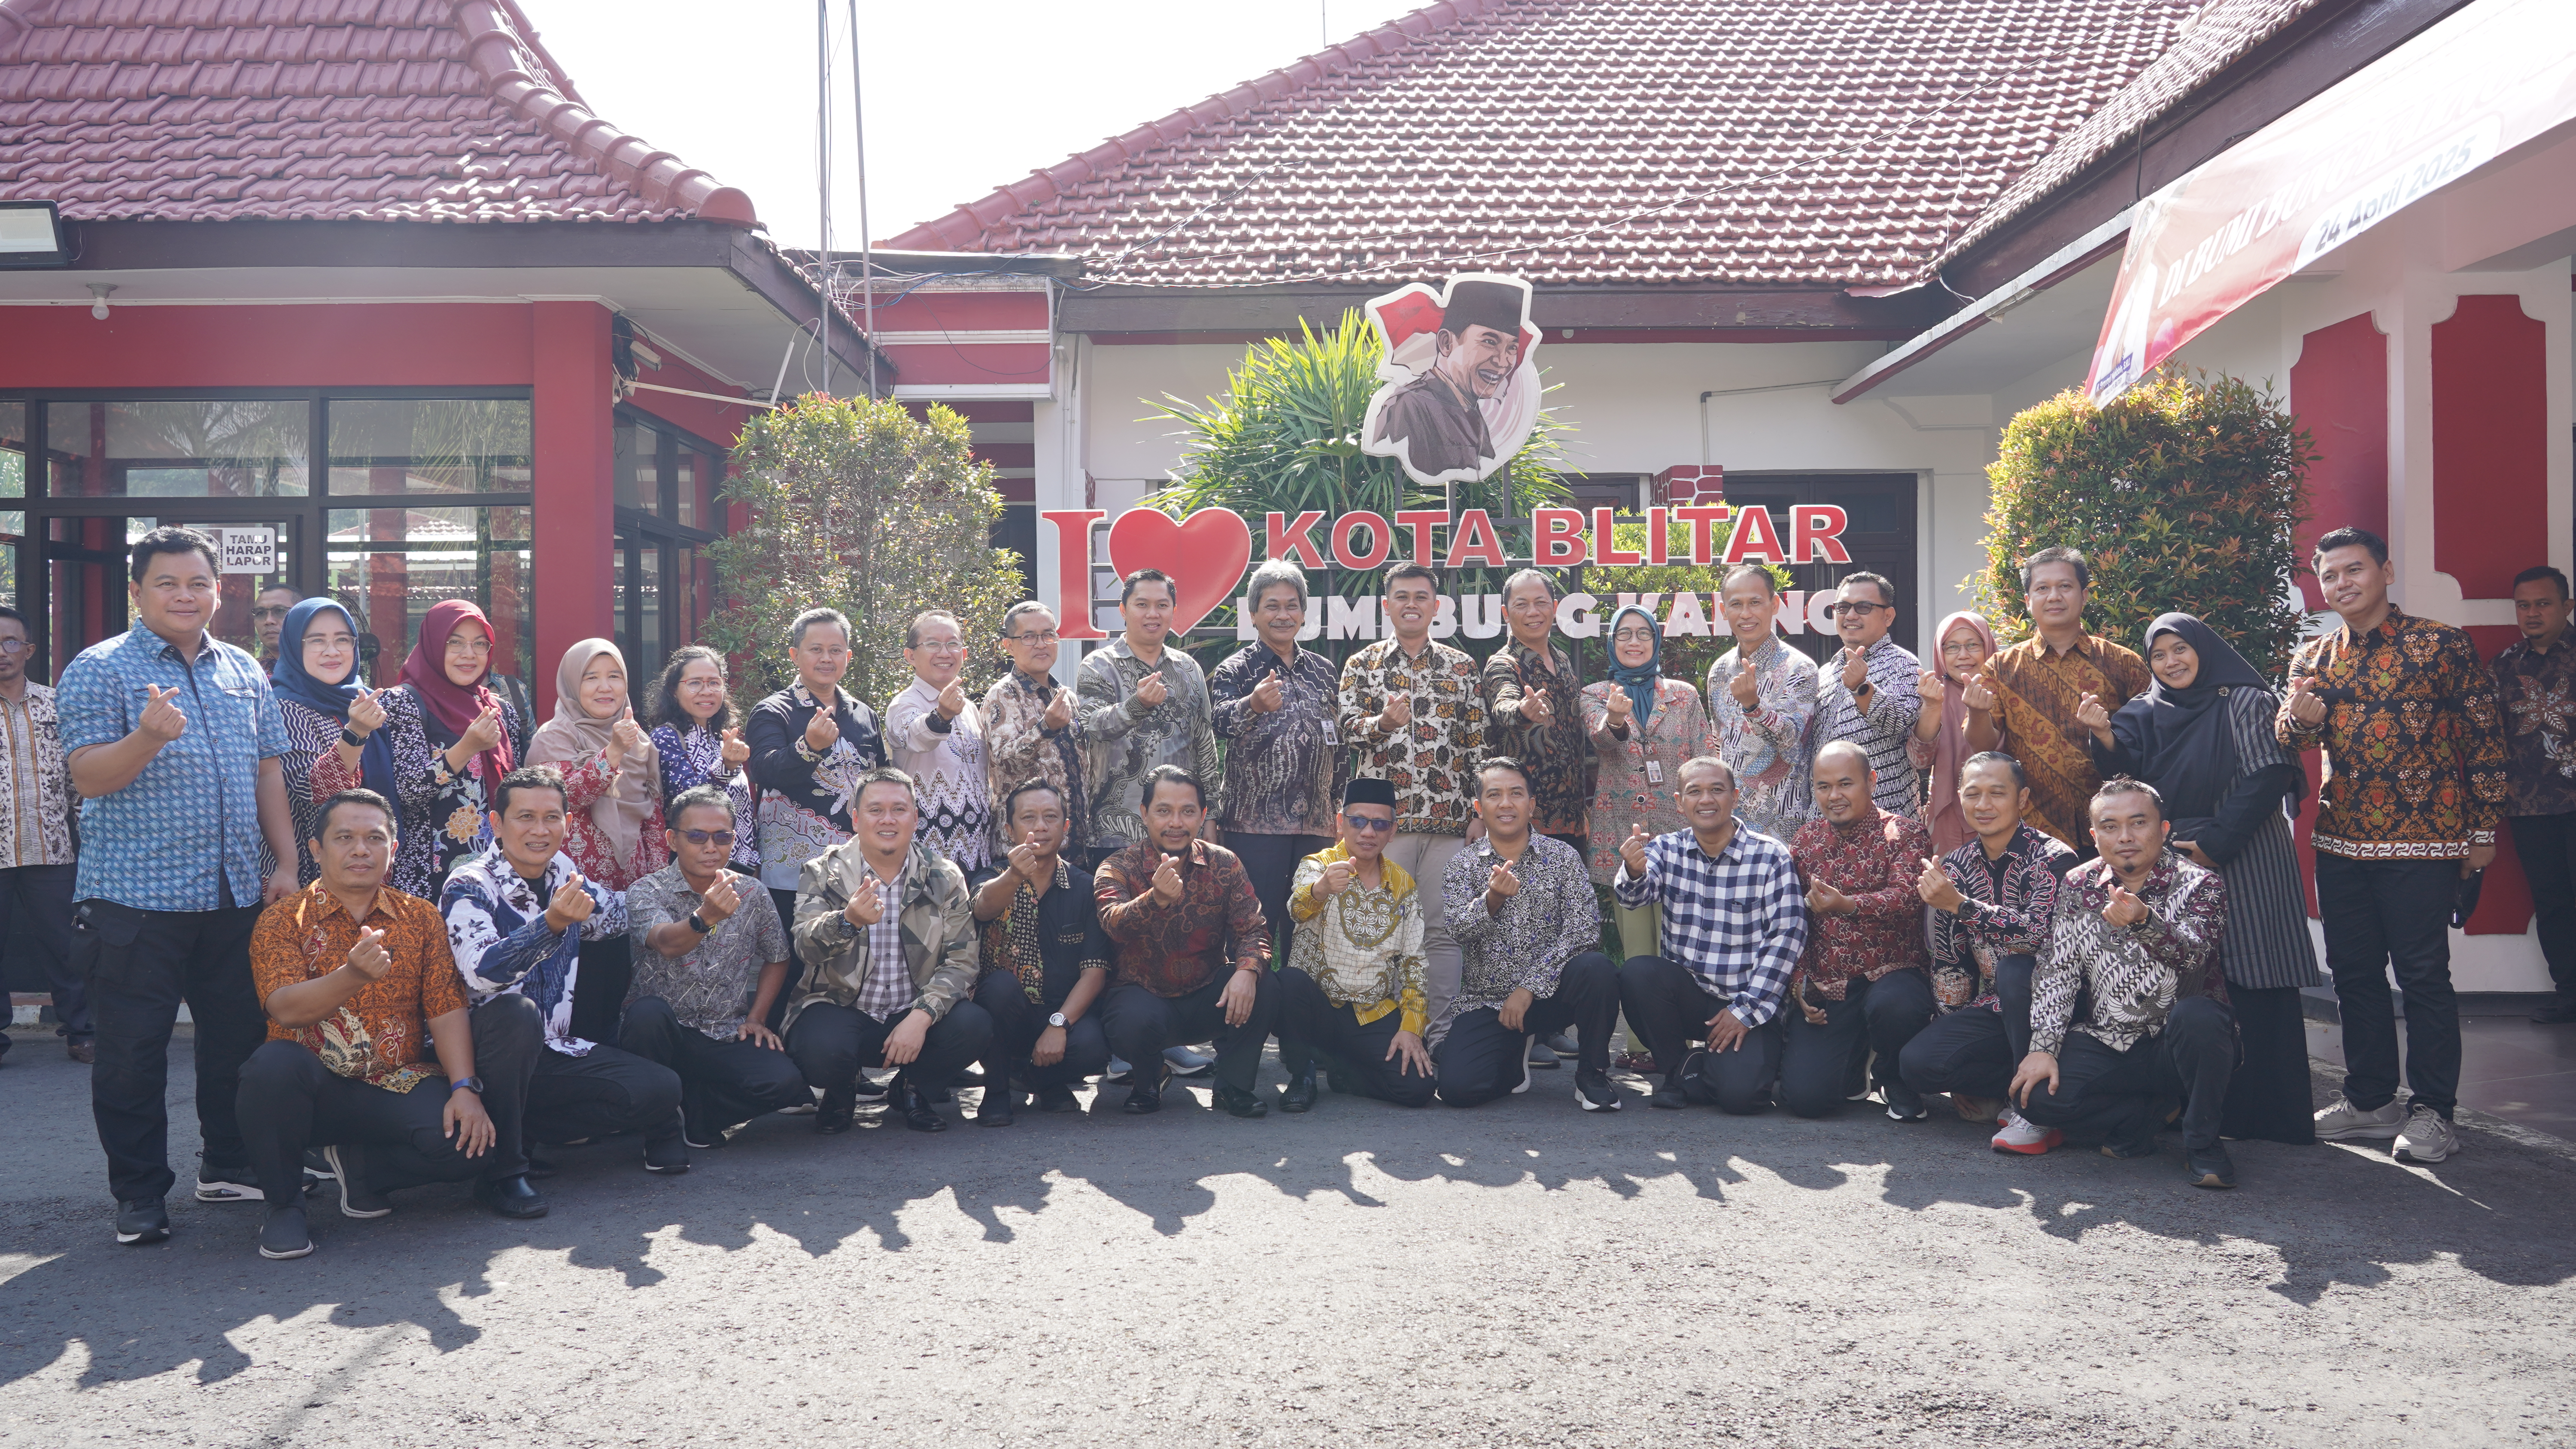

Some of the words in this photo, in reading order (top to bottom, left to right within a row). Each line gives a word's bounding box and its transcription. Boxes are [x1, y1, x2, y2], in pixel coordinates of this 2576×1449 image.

[2315, 212, 2341, 254] 24
[2345, 173, 2406, 233] April
[2406, 133, 2478, 197] 2025
[2158, 249, 2193, 309] DI
[2185, 197, 2267, 288] BUMI
[2256, 131, 2369, 238] BUNG
[226, 546, 271, 555] HARAP
[227, 556, 271, 566] LAPOR
[230, 535, 267, 544] TAMU
[1040, 509, 1110, 640] I
[1266, 509, 1507, 570] KOTA
[1532, 504, 1853, 567] BLITAR
[1428, 592, 1601, 639] BUG
